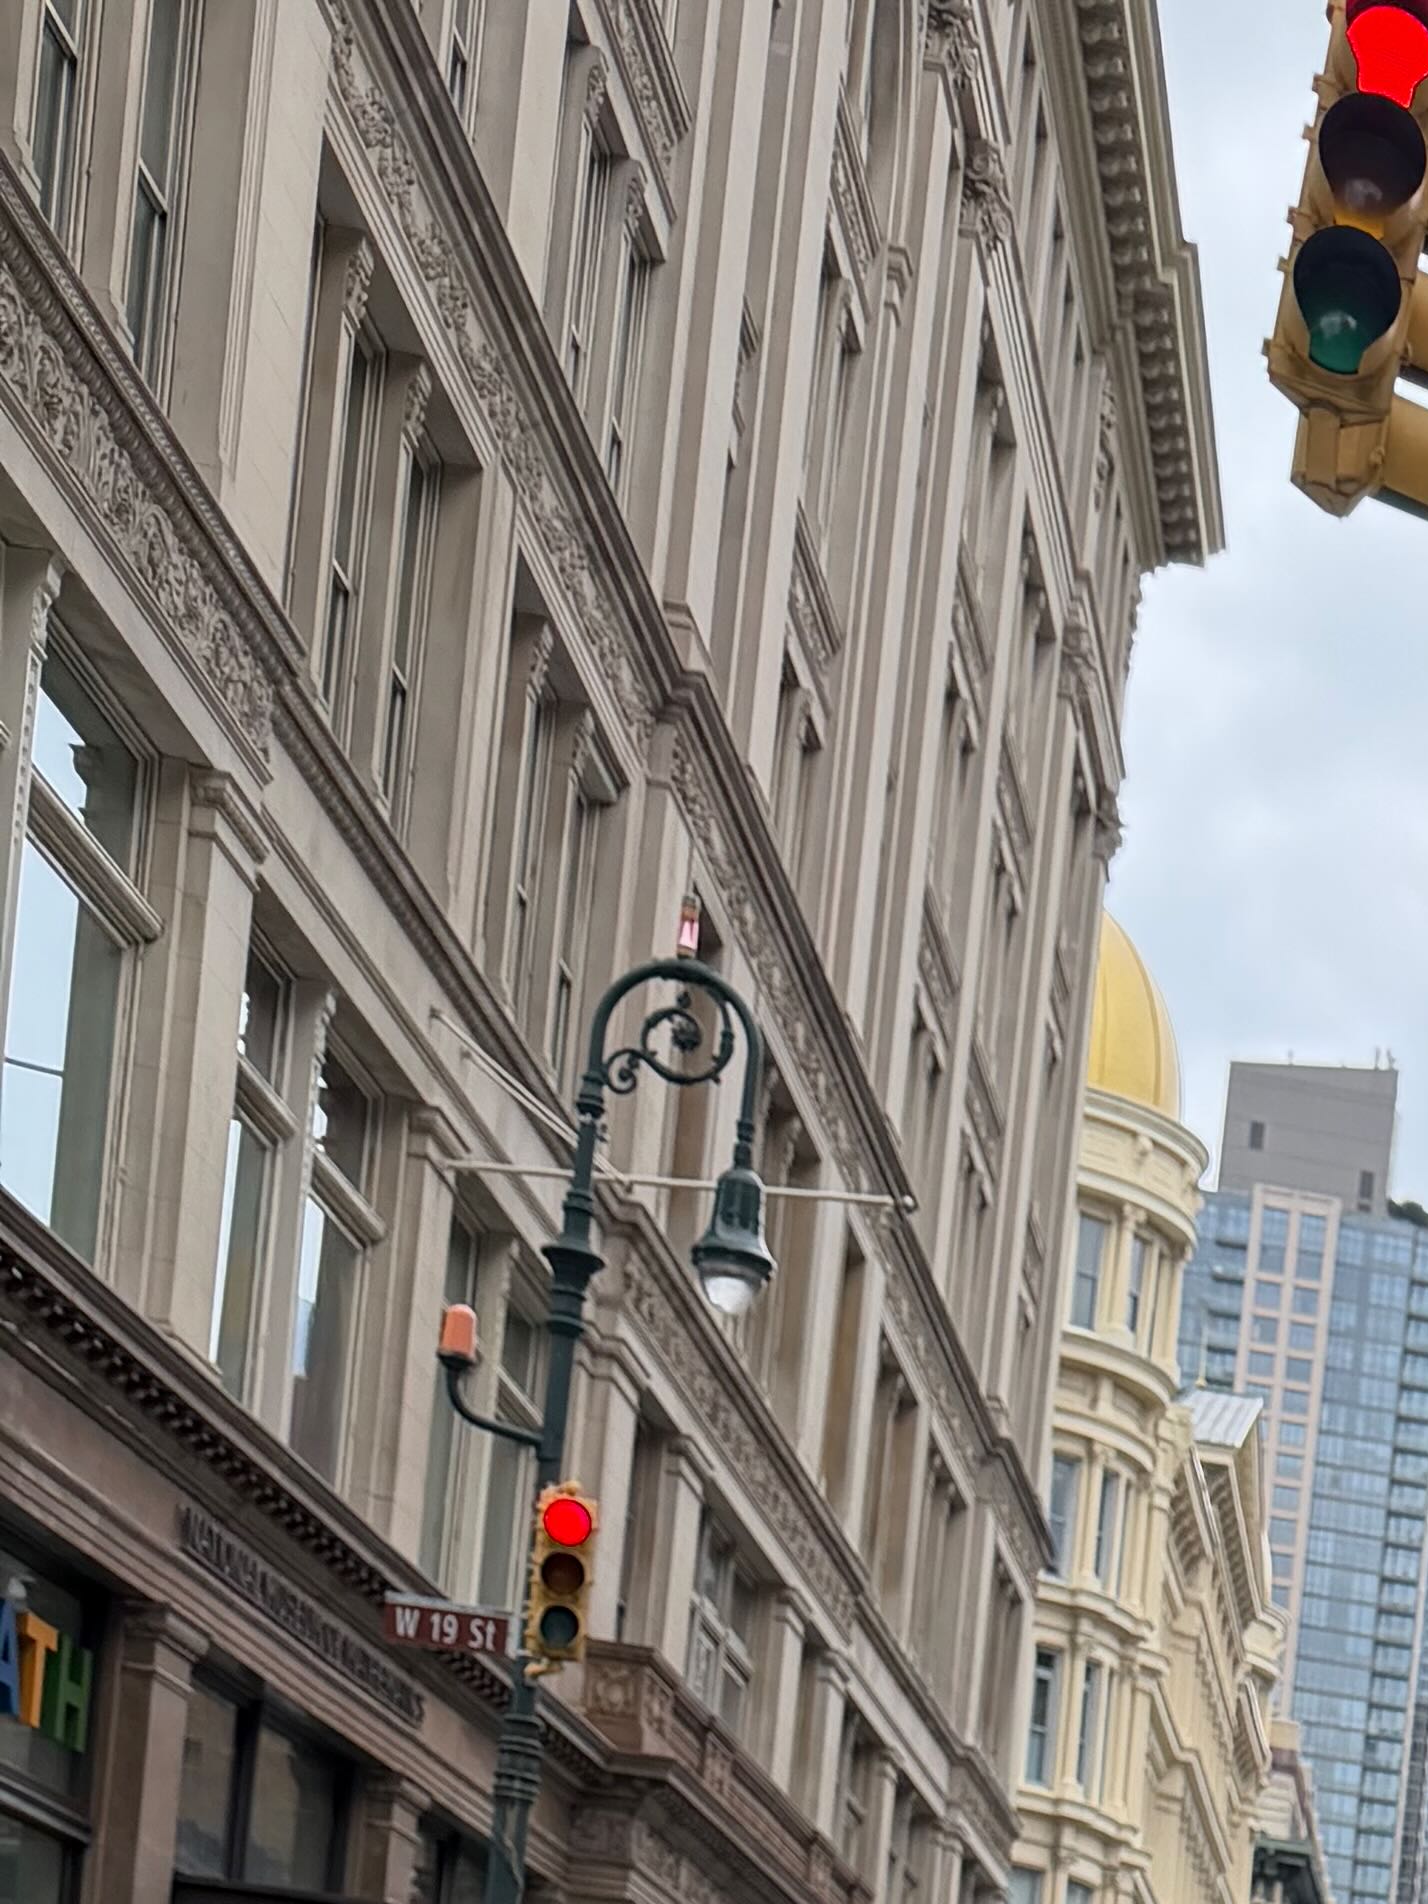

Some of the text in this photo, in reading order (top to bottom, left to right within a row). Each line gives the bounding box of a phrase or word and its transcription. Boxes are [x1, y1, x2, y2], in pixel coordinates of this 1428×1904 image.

[395, 1606, 496, 1652] W 19 St
